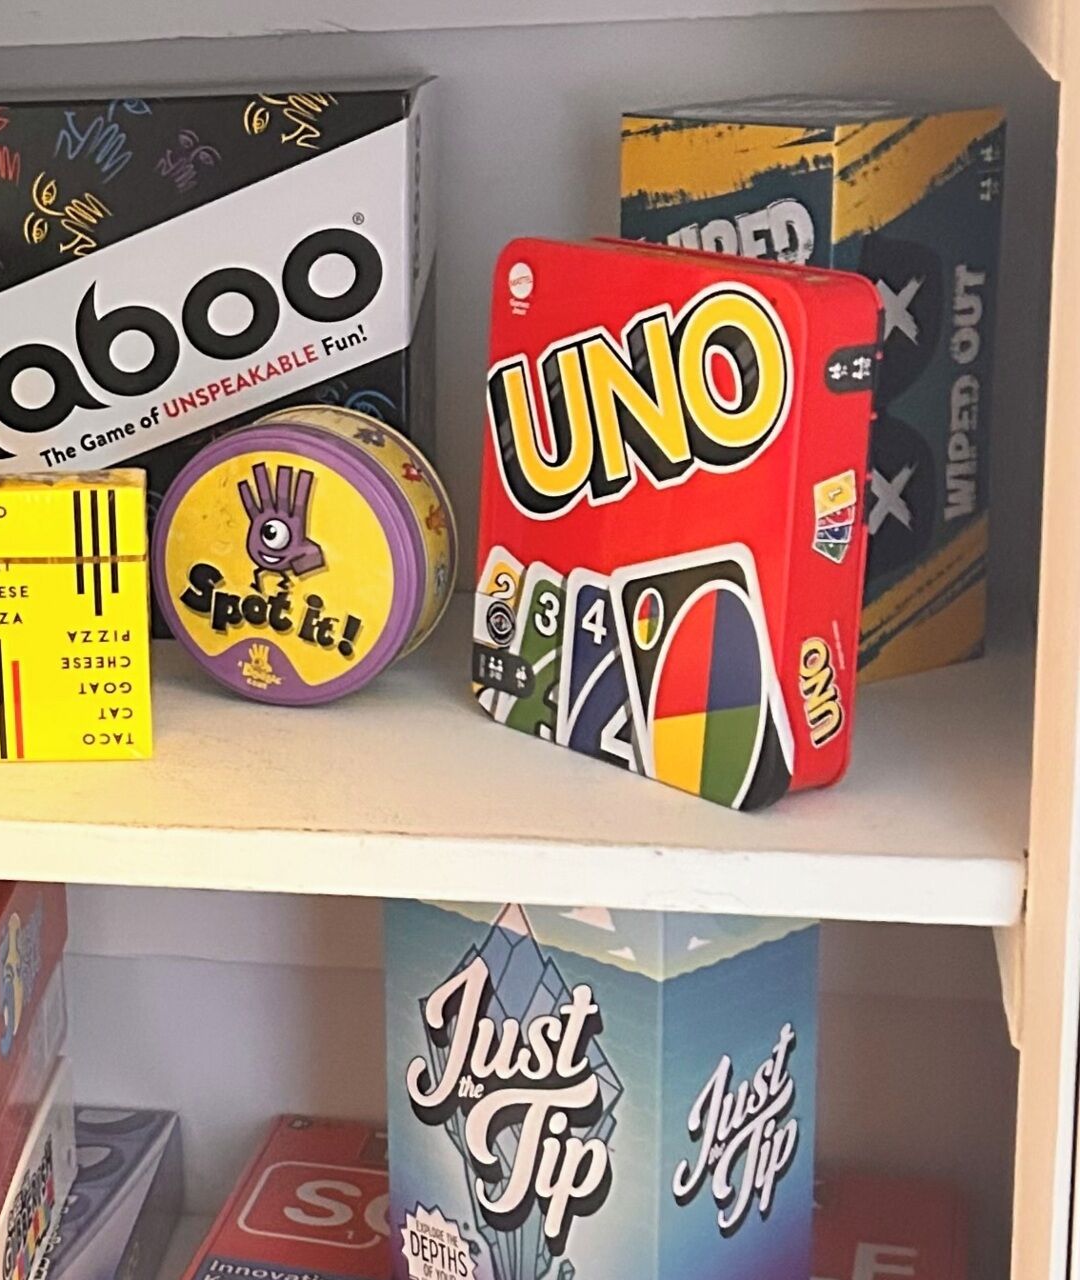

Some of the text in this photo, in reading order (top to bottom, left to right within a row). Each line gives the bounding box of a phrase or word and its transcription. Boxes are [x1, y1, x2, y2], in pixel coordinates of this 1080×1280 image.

[40, 324, 368, 468] The Game of UNSPEAKABLE Fun!
[492, 286, 790, 515] UNO
[945, 264, 986, 520] WIPED OUT
[67, 630, 131, 643] PIZZA
[181, 563, 363, 656] Spot it!
[535, 593, 560, 636] 3
[581, 599, 606, 645] 4
[61, 656, 131, 669] CHEESE
[78, 682, 132, 694] GOAT
[801, 637, 843, 748] UNO
[83, 733, 134, 745] TACO
[98, 708, 133, 719] CAT
[406, 958, 596, 1108] Just
[458, 1076, 484, 1100] the
[674, 1024, 794, 1196] Just
[466, 1074, 608, 1236] Tip
[715, 1119, 796, 1228] Tip
[410, 1231, 467, 1276] DEPTHS
